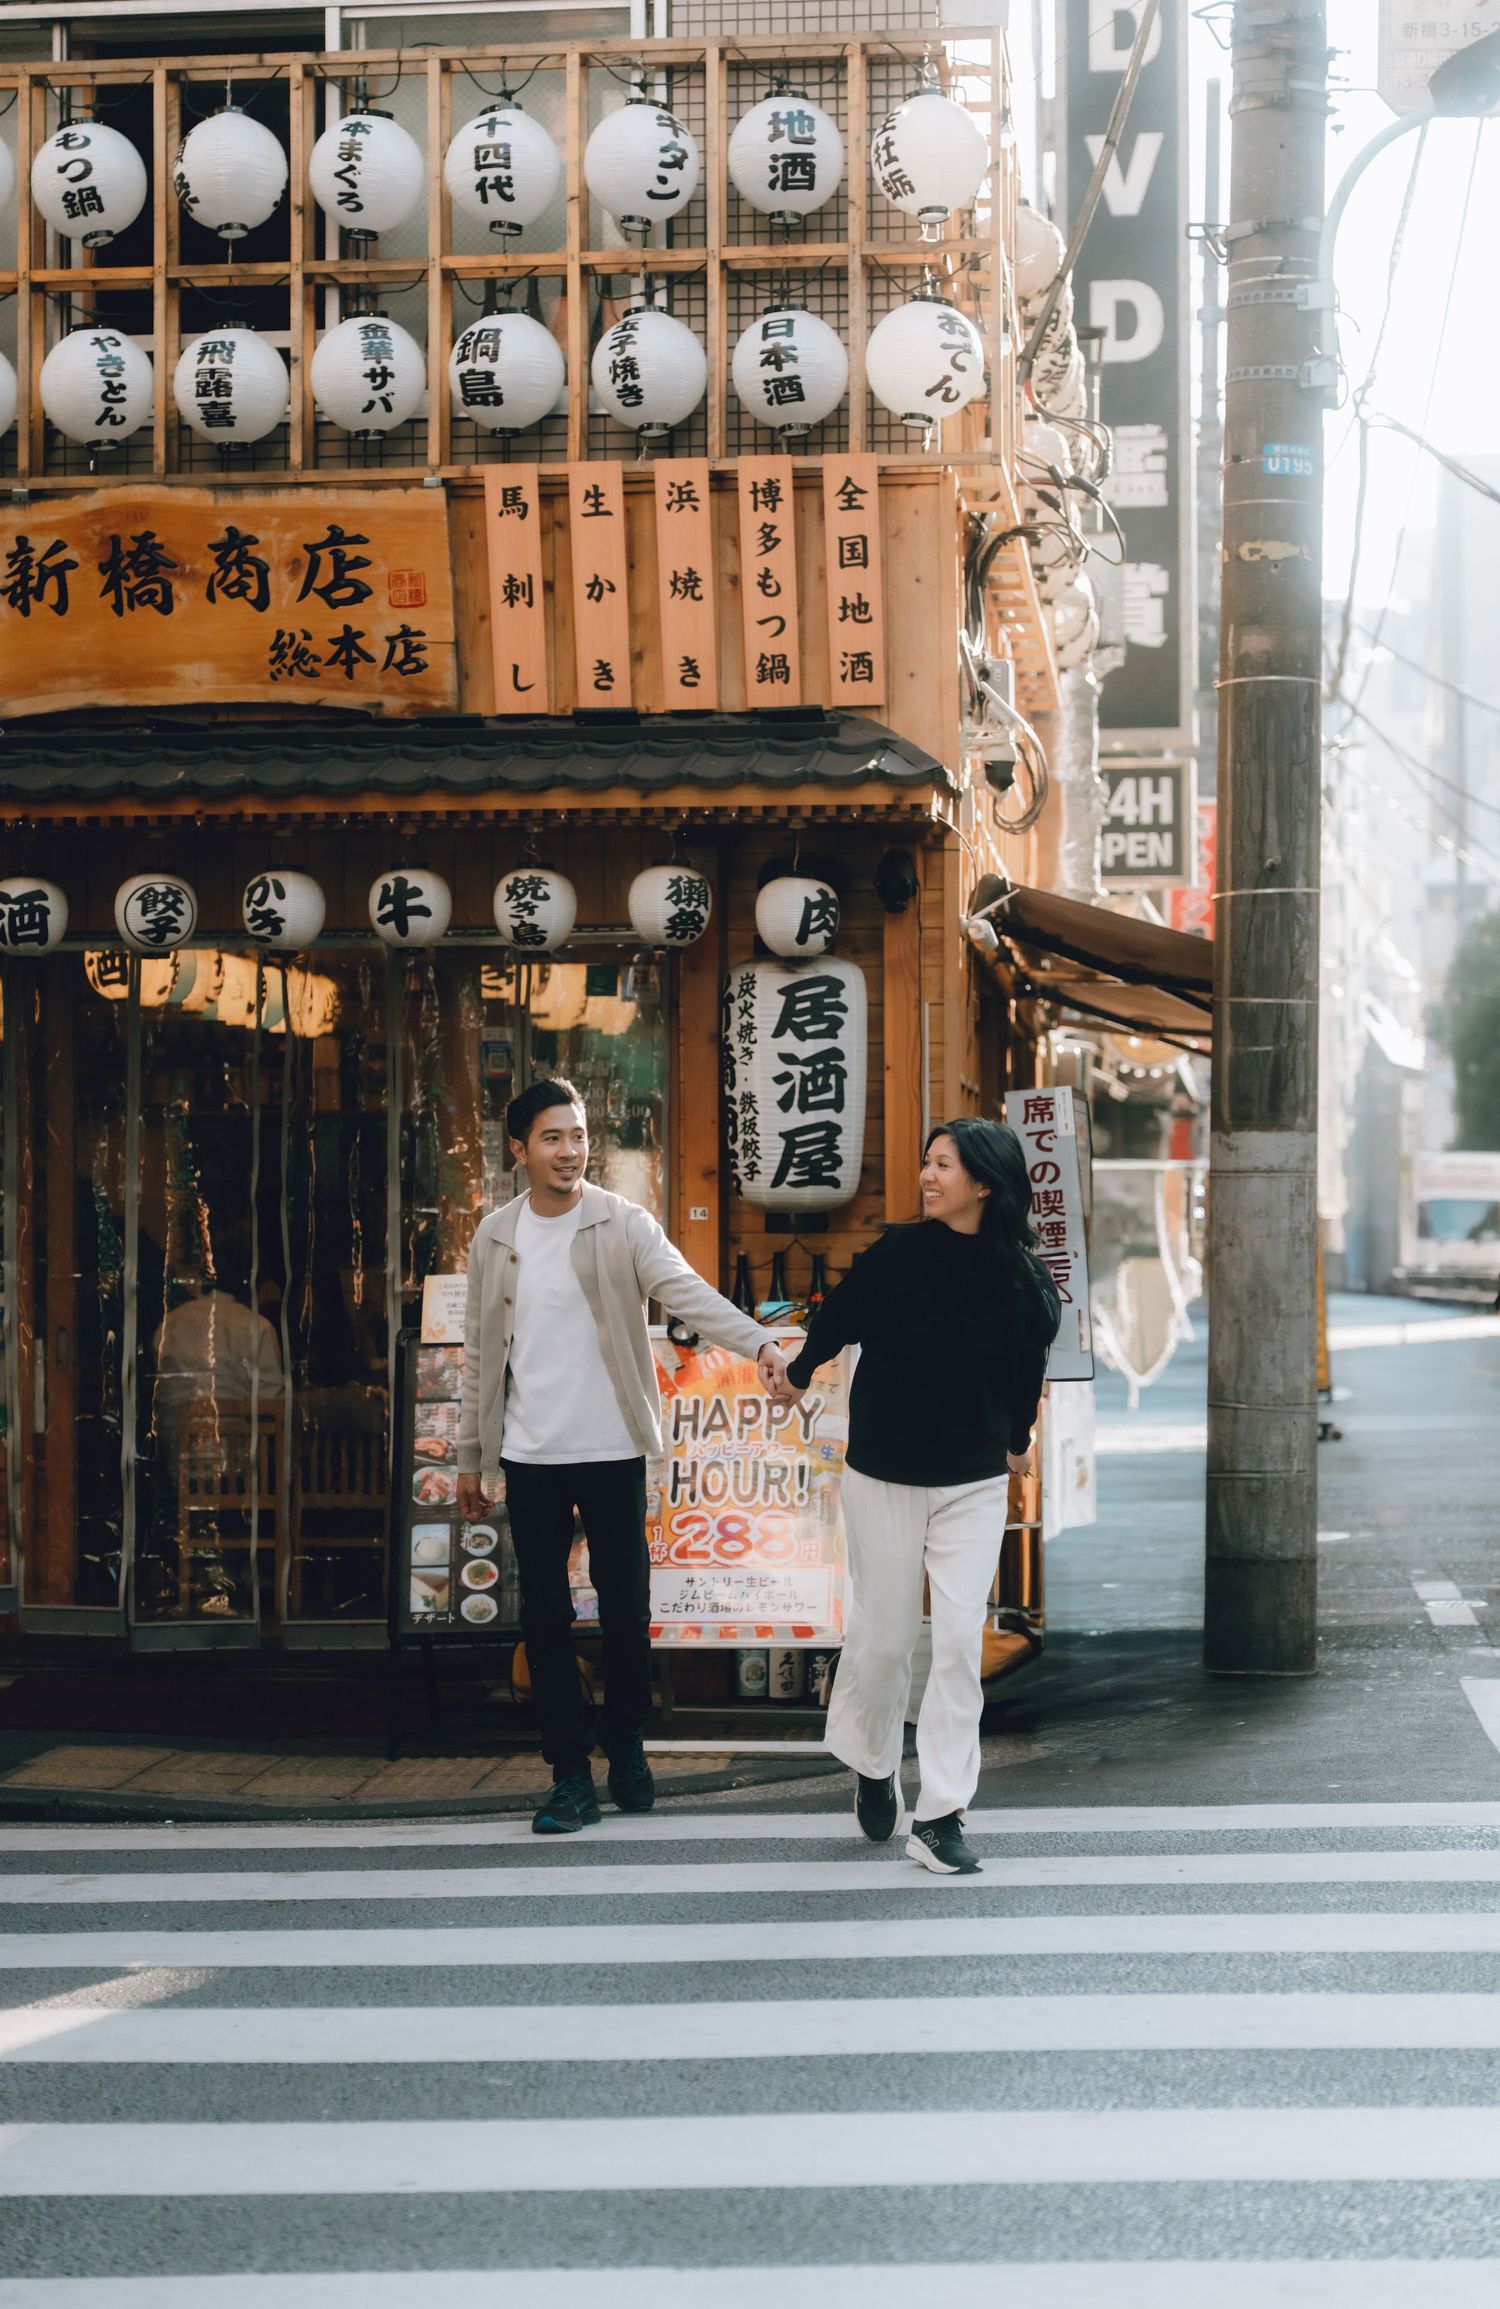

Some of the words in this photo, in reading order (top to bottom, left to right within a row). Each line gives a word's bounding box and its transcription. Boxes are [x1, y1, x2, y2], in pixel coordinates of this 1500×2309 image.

[55, 132, 105, 219] もつ鍋
[333, 121, 372, 213] 本まぐろ
[474, 117, 516, 204] 十四代
[767, 109, 815, 191] 地酒
[90, 337, 126, 426] やきとん
[195, 340, 237, 429] 飛露喜
[358, 324, 395, 415] 金華サバ
[455, 327, 504, 408] 鍋島
[609, 317, 643, 408] 玉子焼き
[759, 317, 805, 406] 日本酒
[924, 311, 972, 404] おでん
[0, 525, 374, 618] 新橋商店
[498, 485, 535, 692] 馬刺し
[580, 483, 616, 691] 生かき
[665, 480, 703, 688] 浜焼き
[749, 478, 790, 685] 博多もつ鍋
[835, 476, 874, 683] 全国地酒
[268, 624, 429, 682] 総本店
[1101, 832, 1173, 867] PEN
[136, 885, 185, 944] 餃子
[246, 876, 286, 943] かき
[376, 876, 431, 937] 牛
[504, 875, 551, 946] 焼き鳥
[664, 875, 709, 940] 獺祭
[795, 888, 838, 946] 肉
[737, 972, 762, 1182] 炭火焼き・鉄板餃子
[771, 974, 848, 1190] 居酒屋
[692, 1208, 708, 1219] 14
[671, 1396, 824, 1444] HAPPY
[669, 1457, 809, 1507] HOUR!
[412, 1613, 455, 1624] デザート
